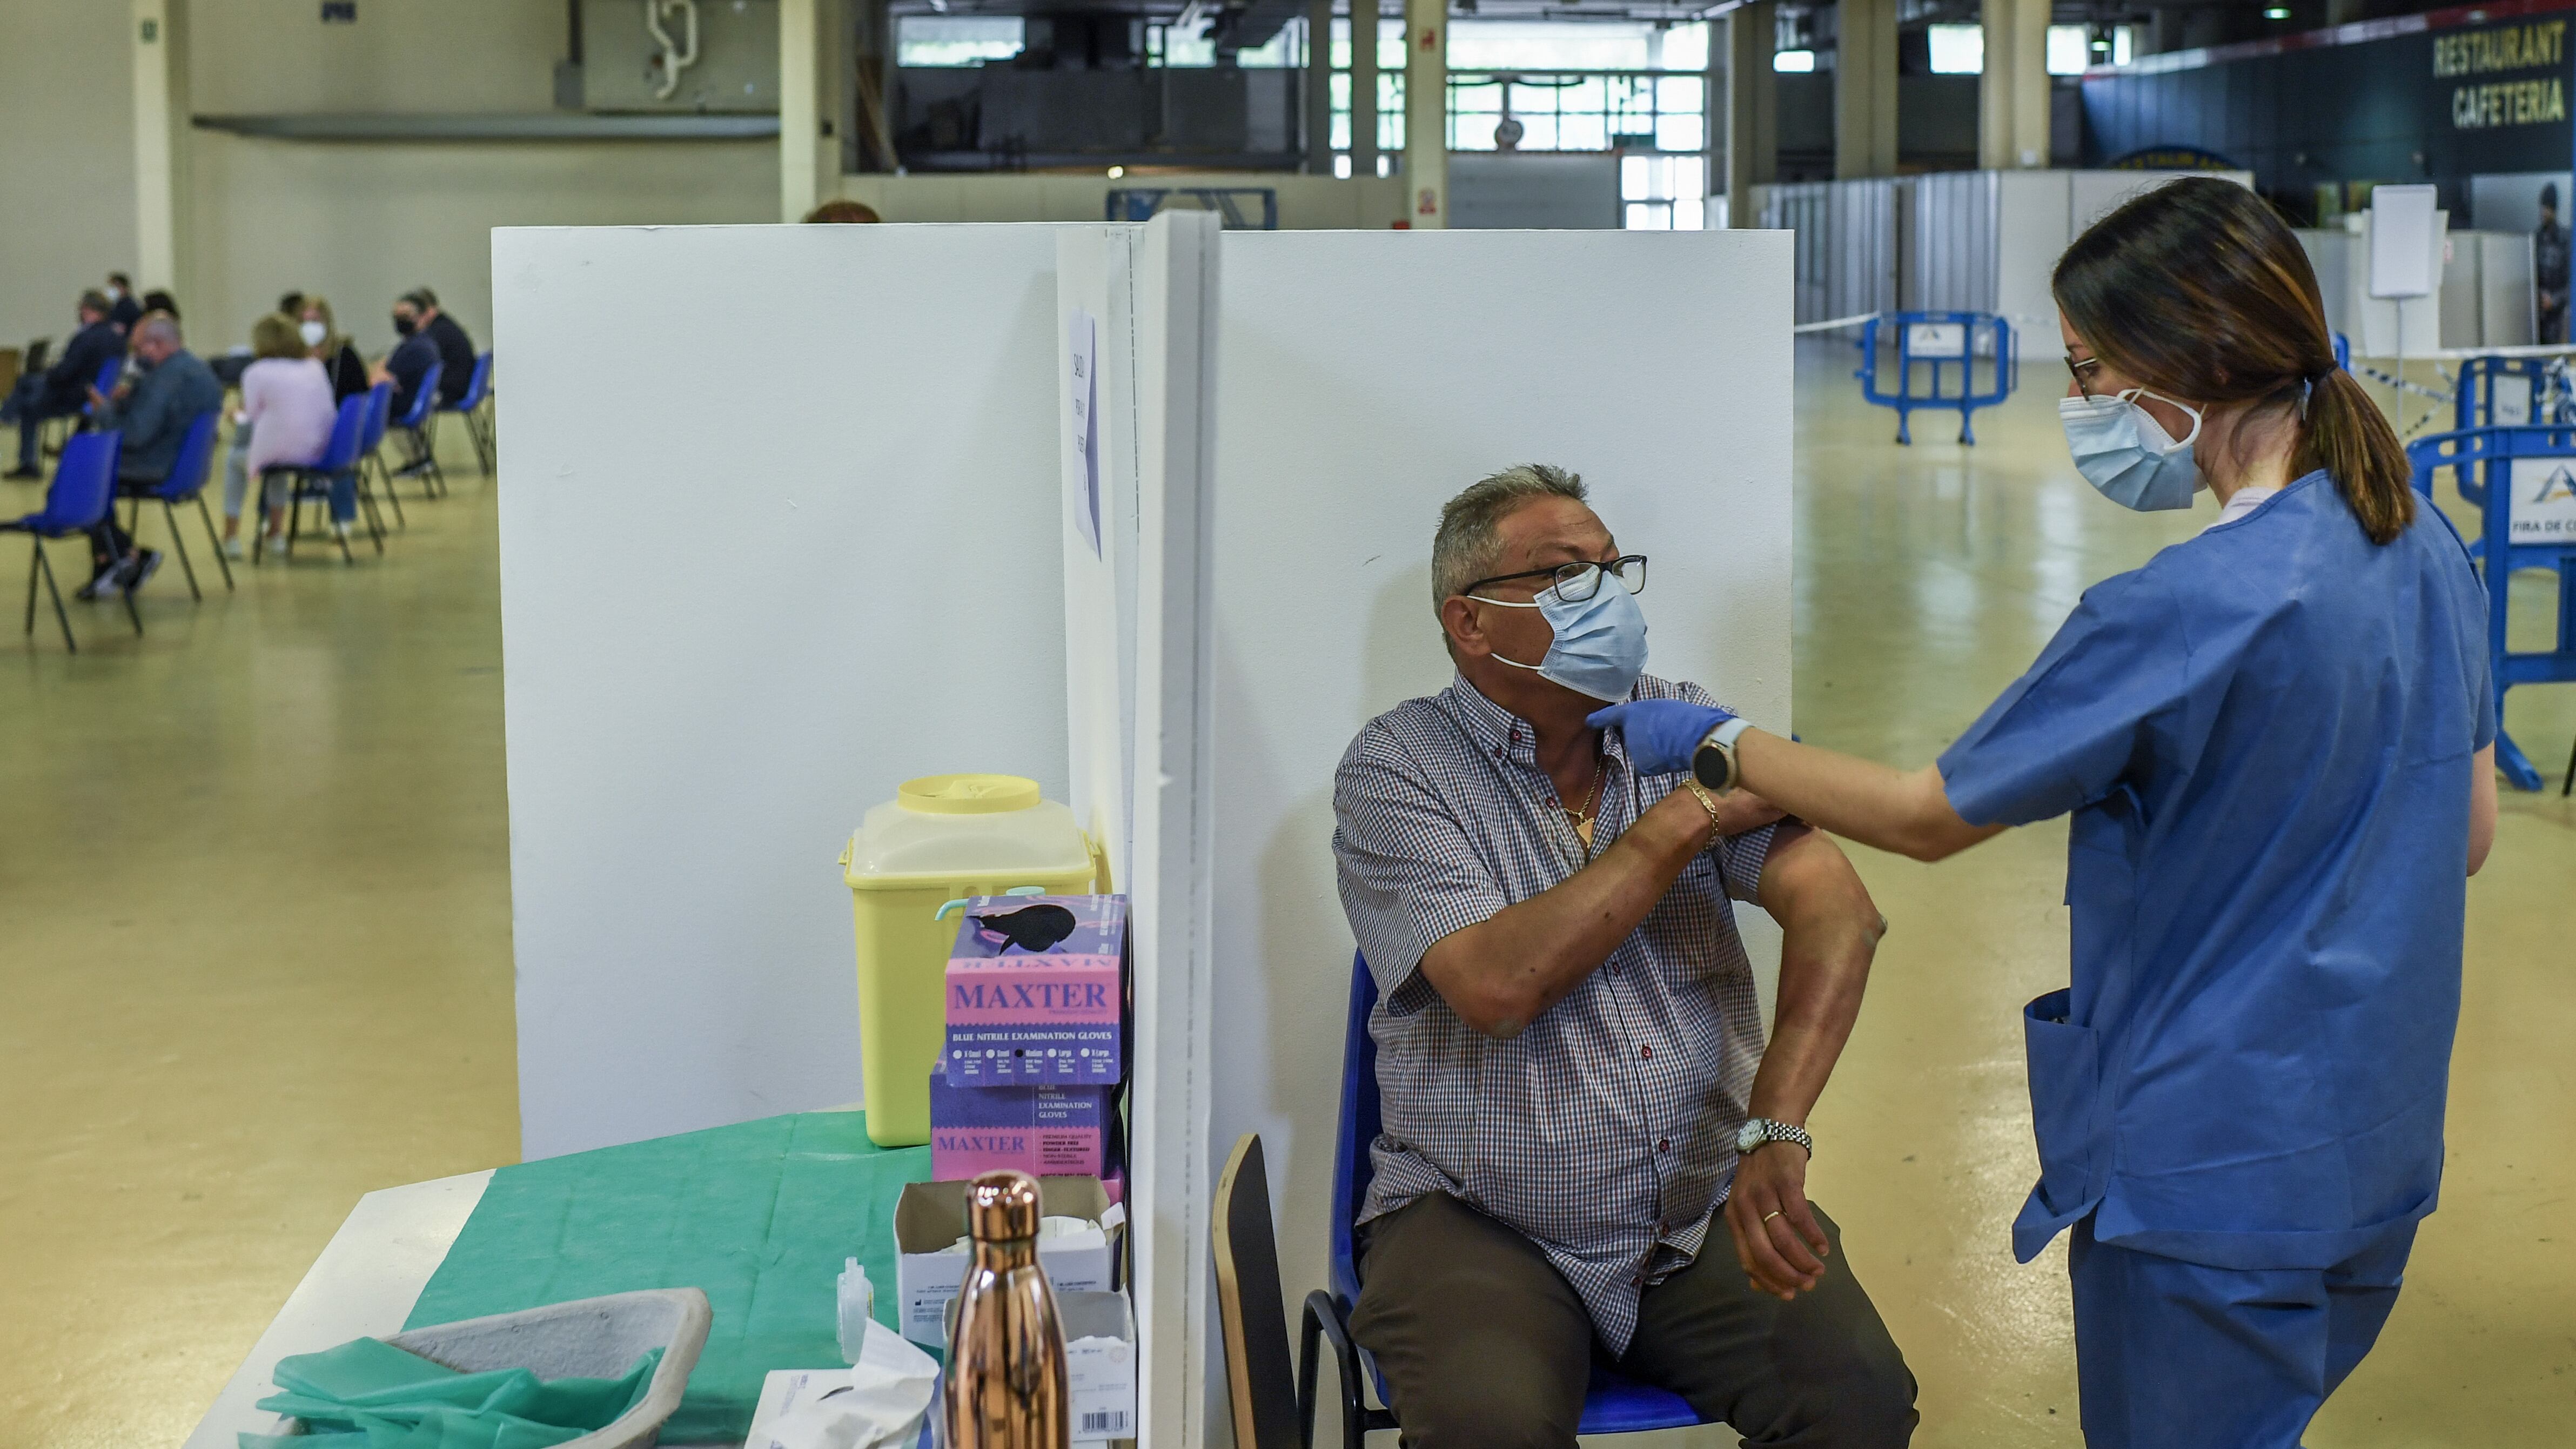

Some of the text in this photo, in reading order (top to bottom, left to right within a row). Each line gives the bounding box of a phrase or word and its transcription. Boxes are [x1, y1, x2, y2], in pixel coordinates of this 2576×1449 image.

[2434, 21, 2565, 77] RESTAURANT
[2453, 78, 2565, 129] CAFETERIA
[2513, 520, 2541, 532] FIRA
[2545, 520, 2560, 532] DE
[955, 983, 1106, 1009] MAXTER
[1012, 1032, 1076, 1041] EXAMINATION
[938, 1136, 1025, 1151] MAXTER
